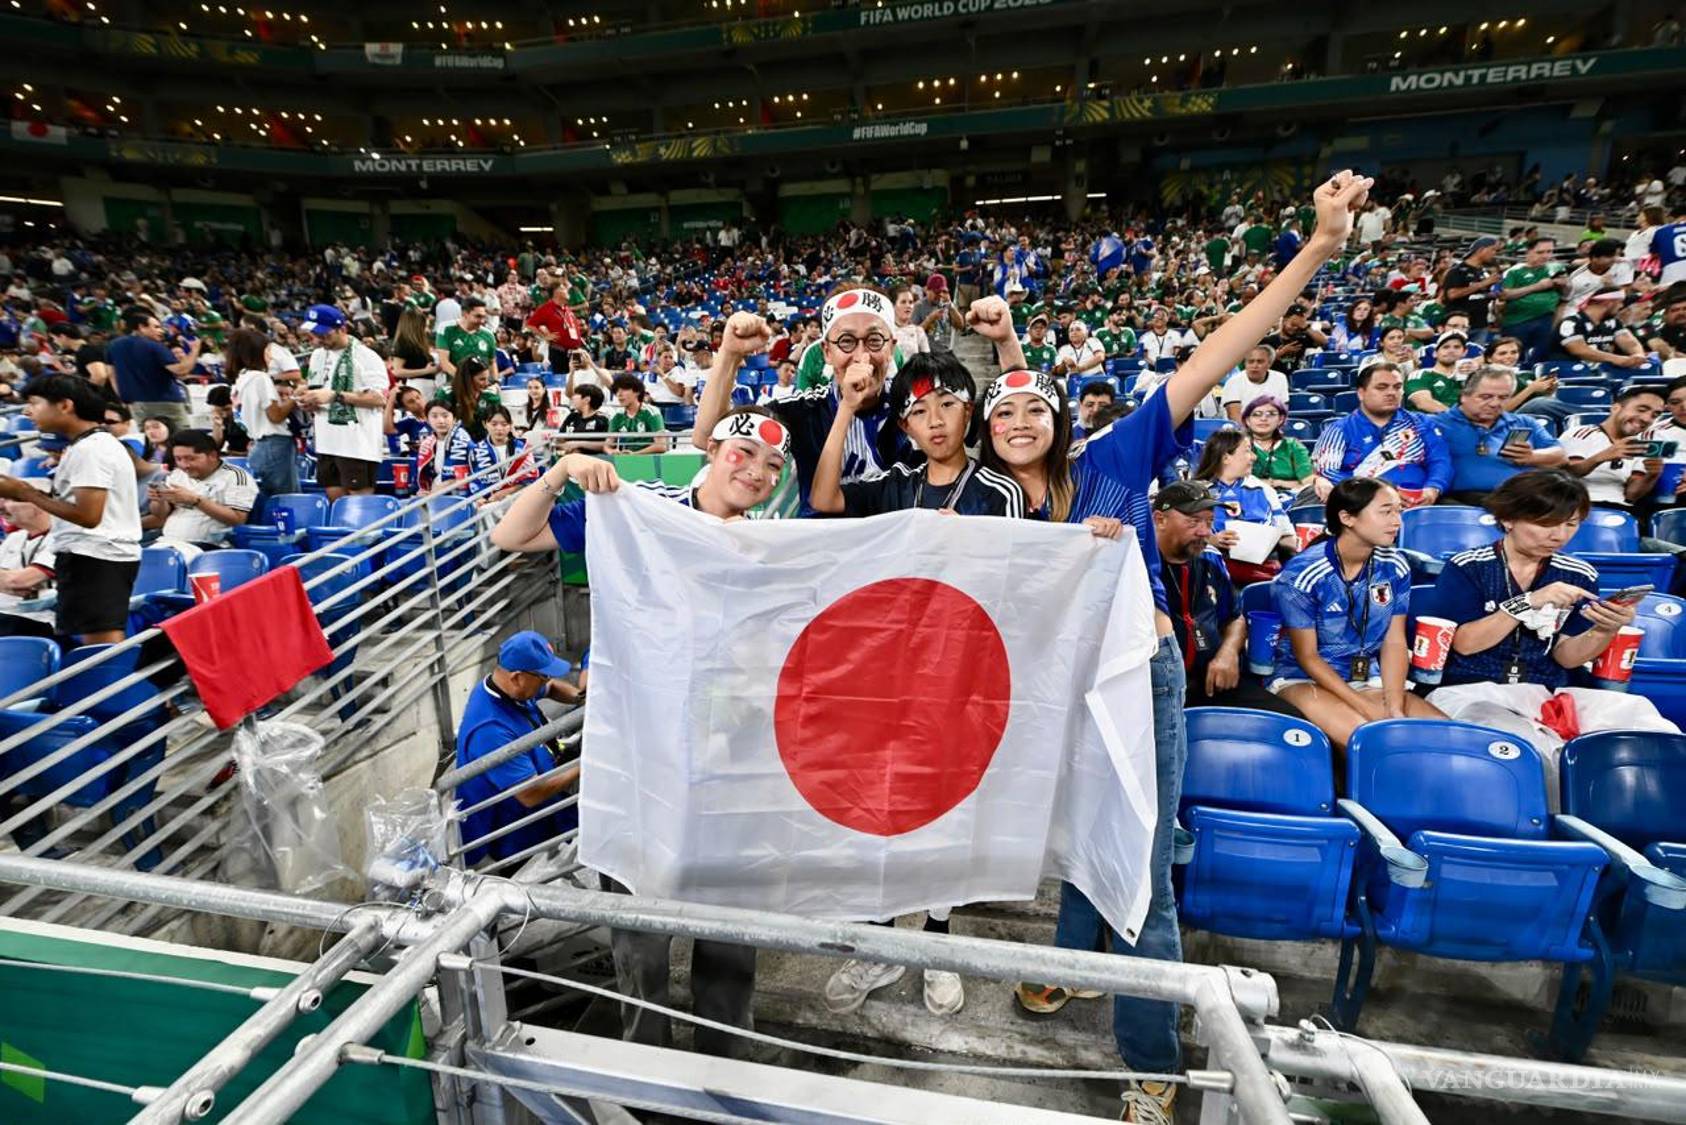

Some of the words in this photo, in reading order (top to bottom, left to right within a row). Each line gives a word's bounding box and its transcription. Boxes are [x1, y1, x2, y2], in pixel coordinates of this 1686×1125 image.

[860, 8, 893, 26] FIFA
[895, 1, 955, 20] WORLD
[957, 0, 992, 14] CUP
[1390, 57, 1598, 92] MONTERREY
[853, 121, 928, 140] #FIFAWorldCup
[353, 159, 494, 172] MONTERREY
[729, 413, 755, 436] 必
[1294, 733, 1300, 743] 1
[1499, 745, 1509, 756] 2
